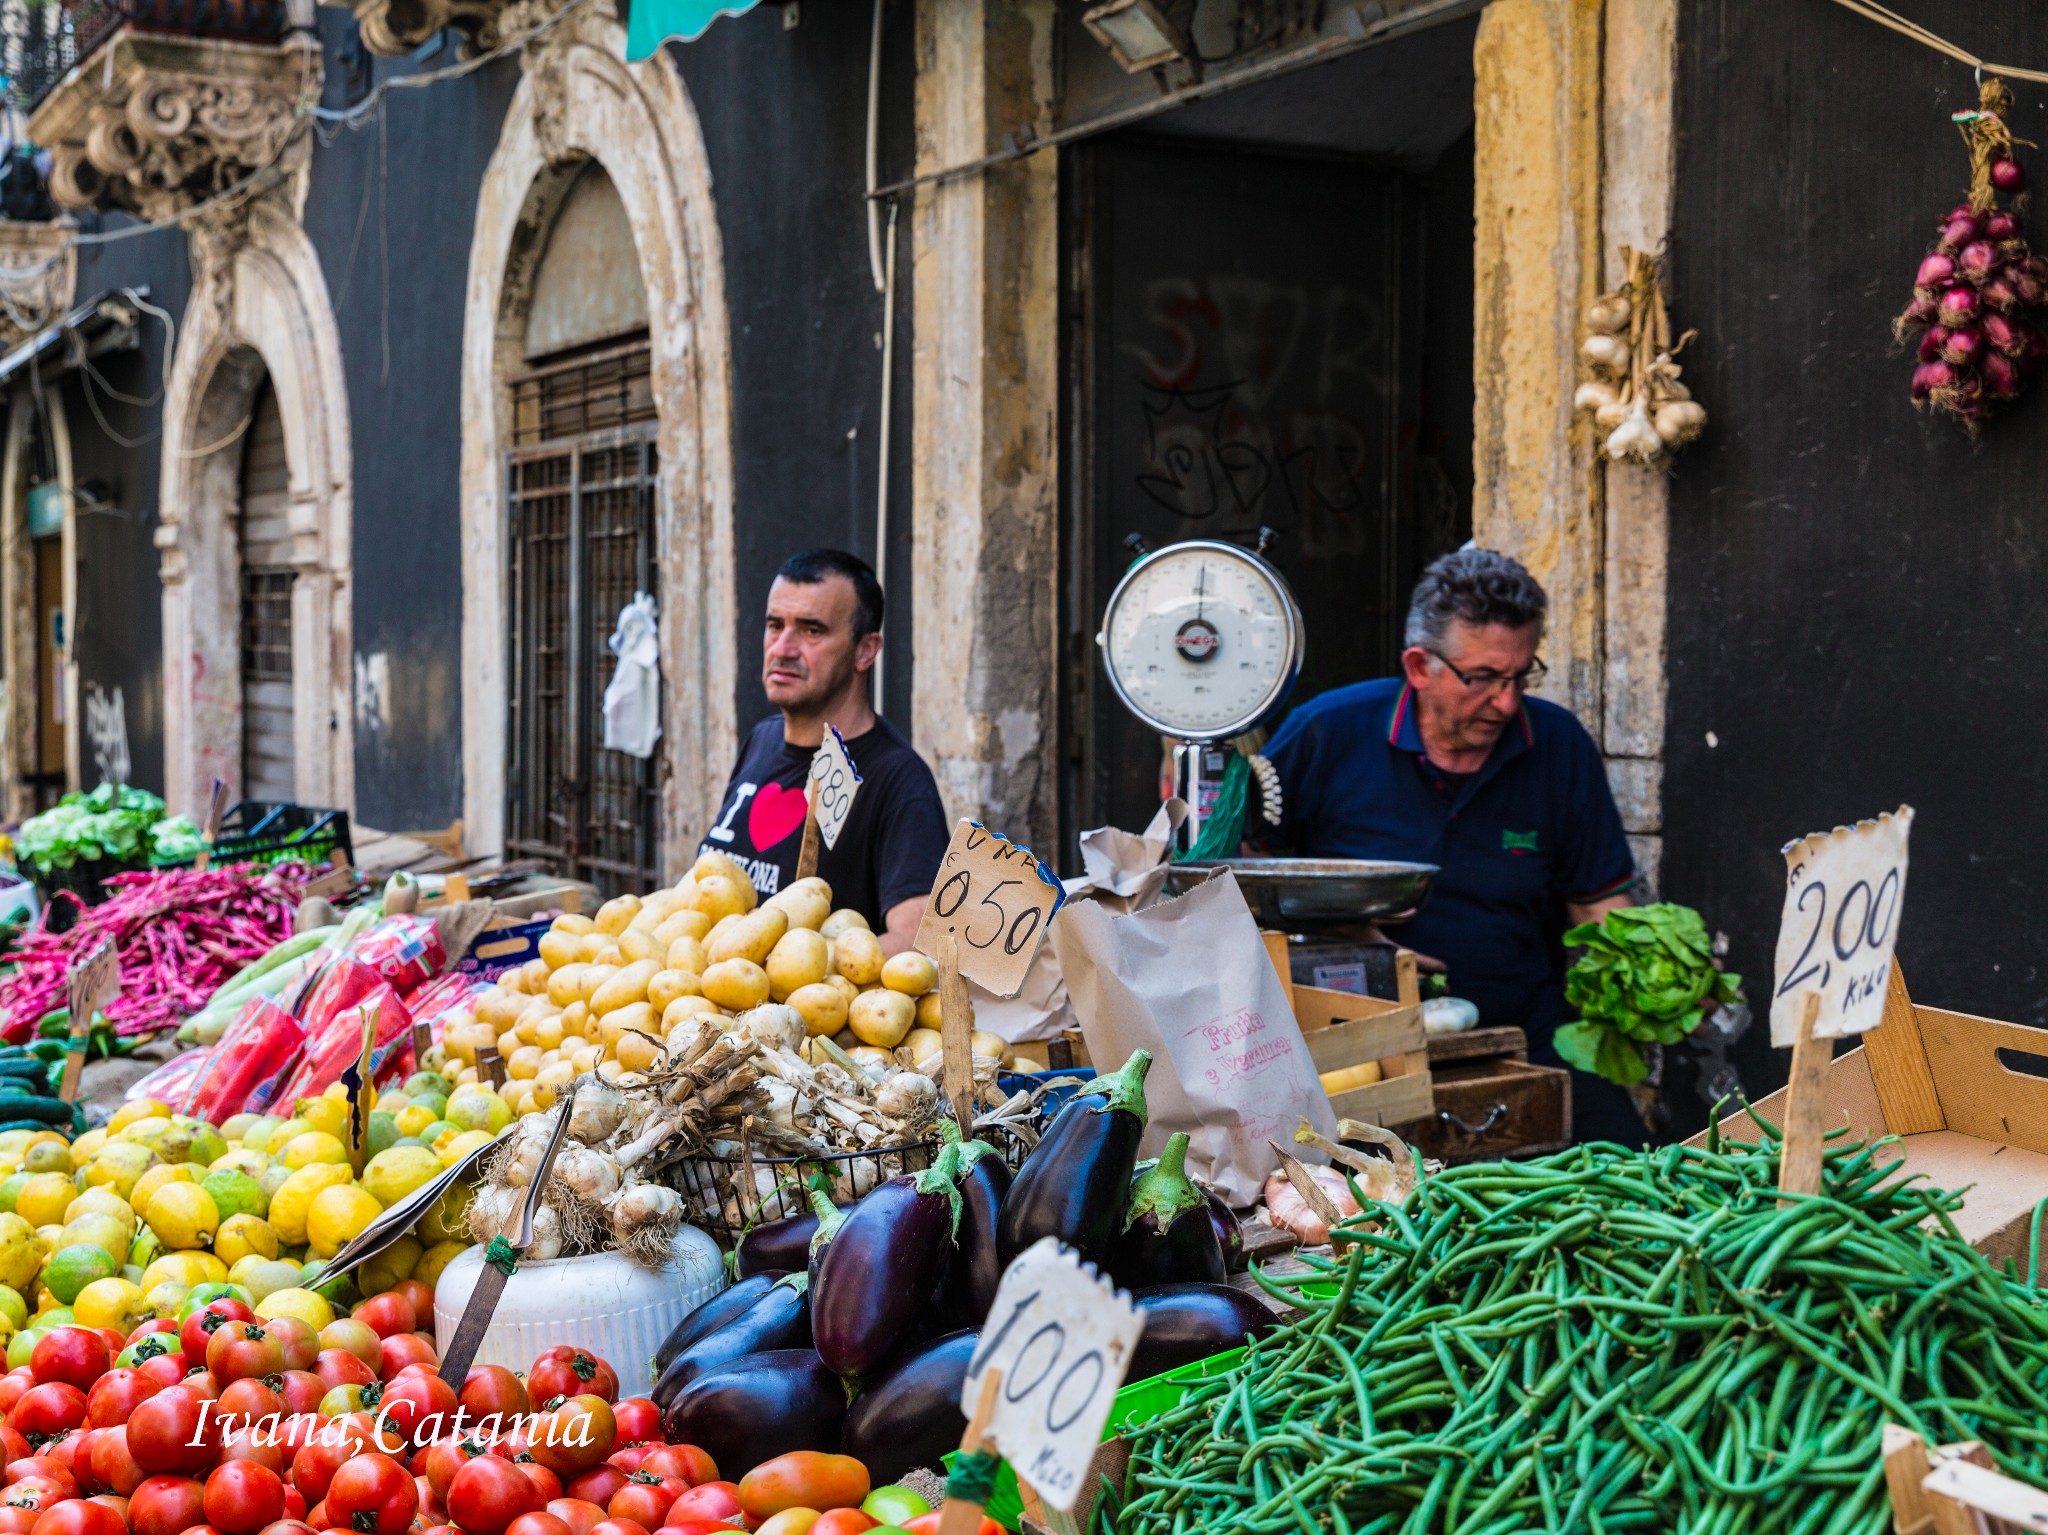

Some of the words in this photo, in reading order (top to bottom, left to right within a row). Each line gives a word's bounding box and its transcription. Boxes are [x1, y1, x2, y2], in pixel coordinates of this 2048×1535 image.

[1175, 634, 1219, 648] OMEGA
[709, 781, 758, 843] I
[966, 829, 1037, 873] UNA
[1776, 866, 1899, 999] 2,00
[1202, 1011, 1267, 1052] Frutta
[1216, 1035, 1293, 1078] Verdura
